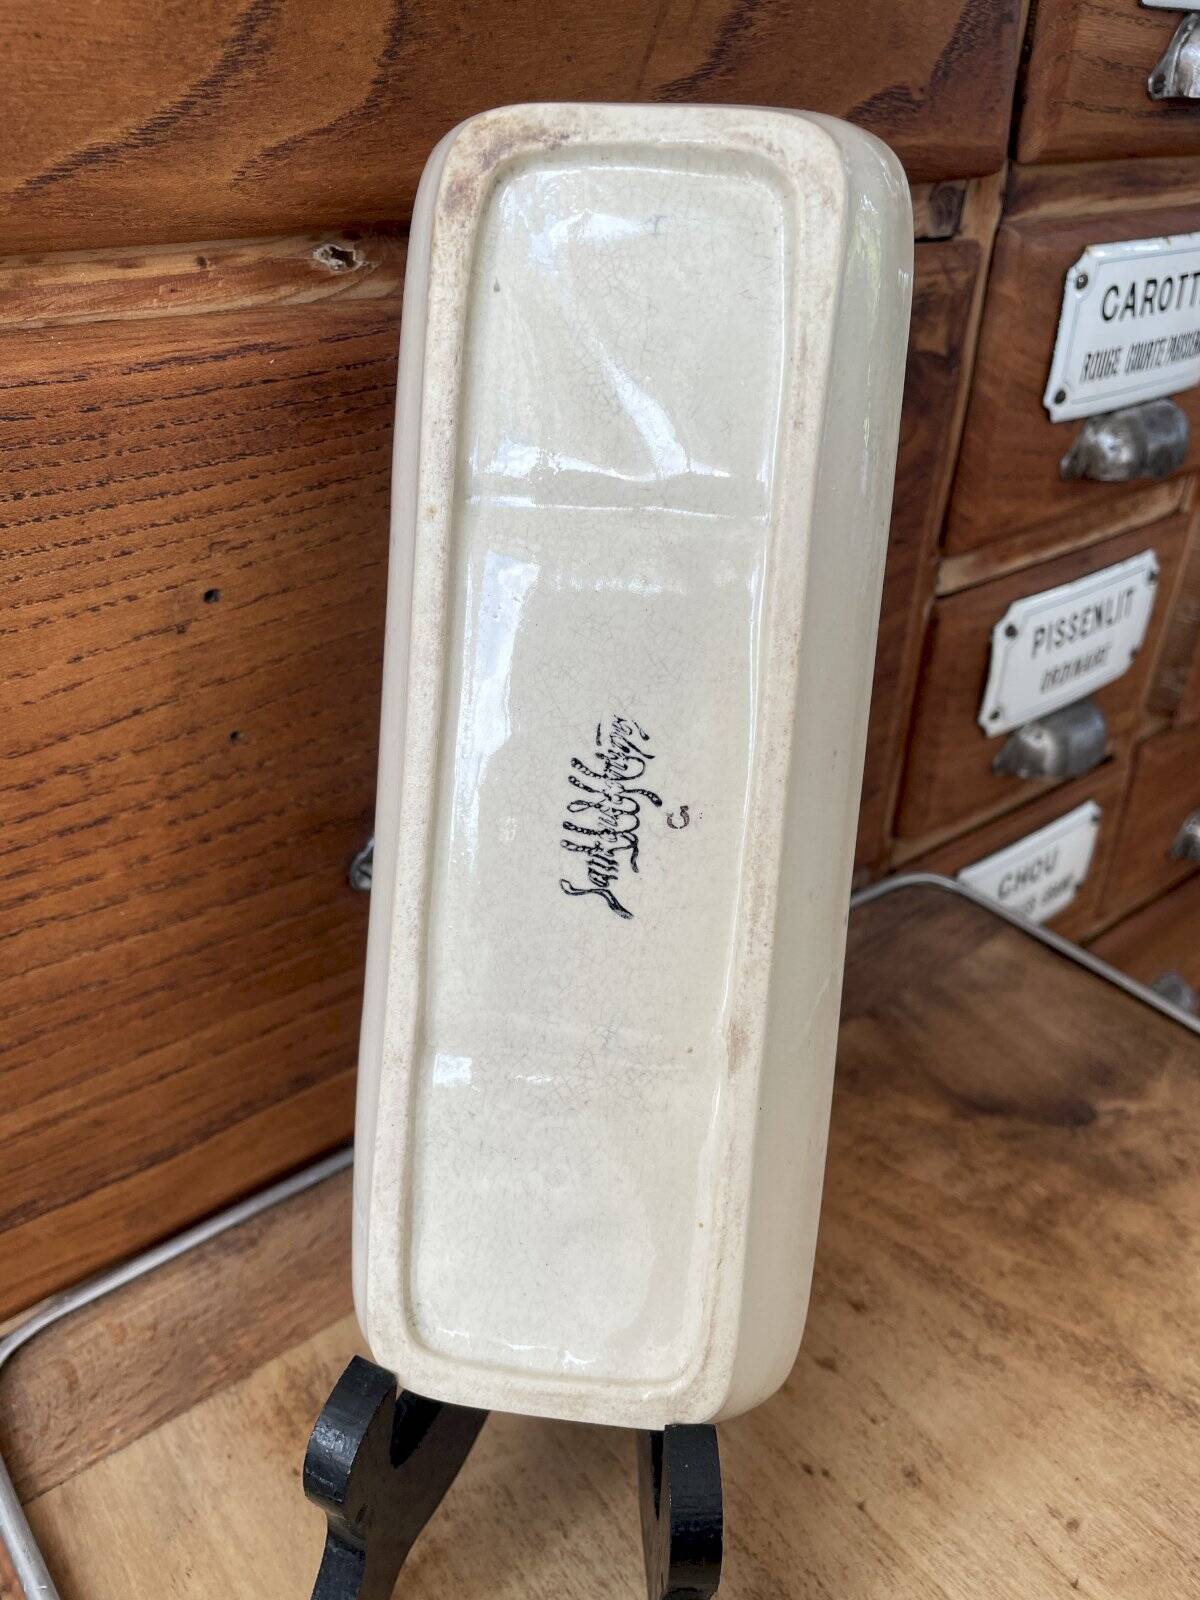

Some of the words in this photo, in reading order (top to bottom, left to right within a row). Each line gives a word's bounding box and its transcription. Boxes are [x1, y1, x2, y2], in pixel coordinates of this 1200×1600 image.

[1102, 271, 1200, 321] CAROTT
[1031, 587, 1134, 658] PISSENLIT
[998, 848, 1059, 899] CHOU
